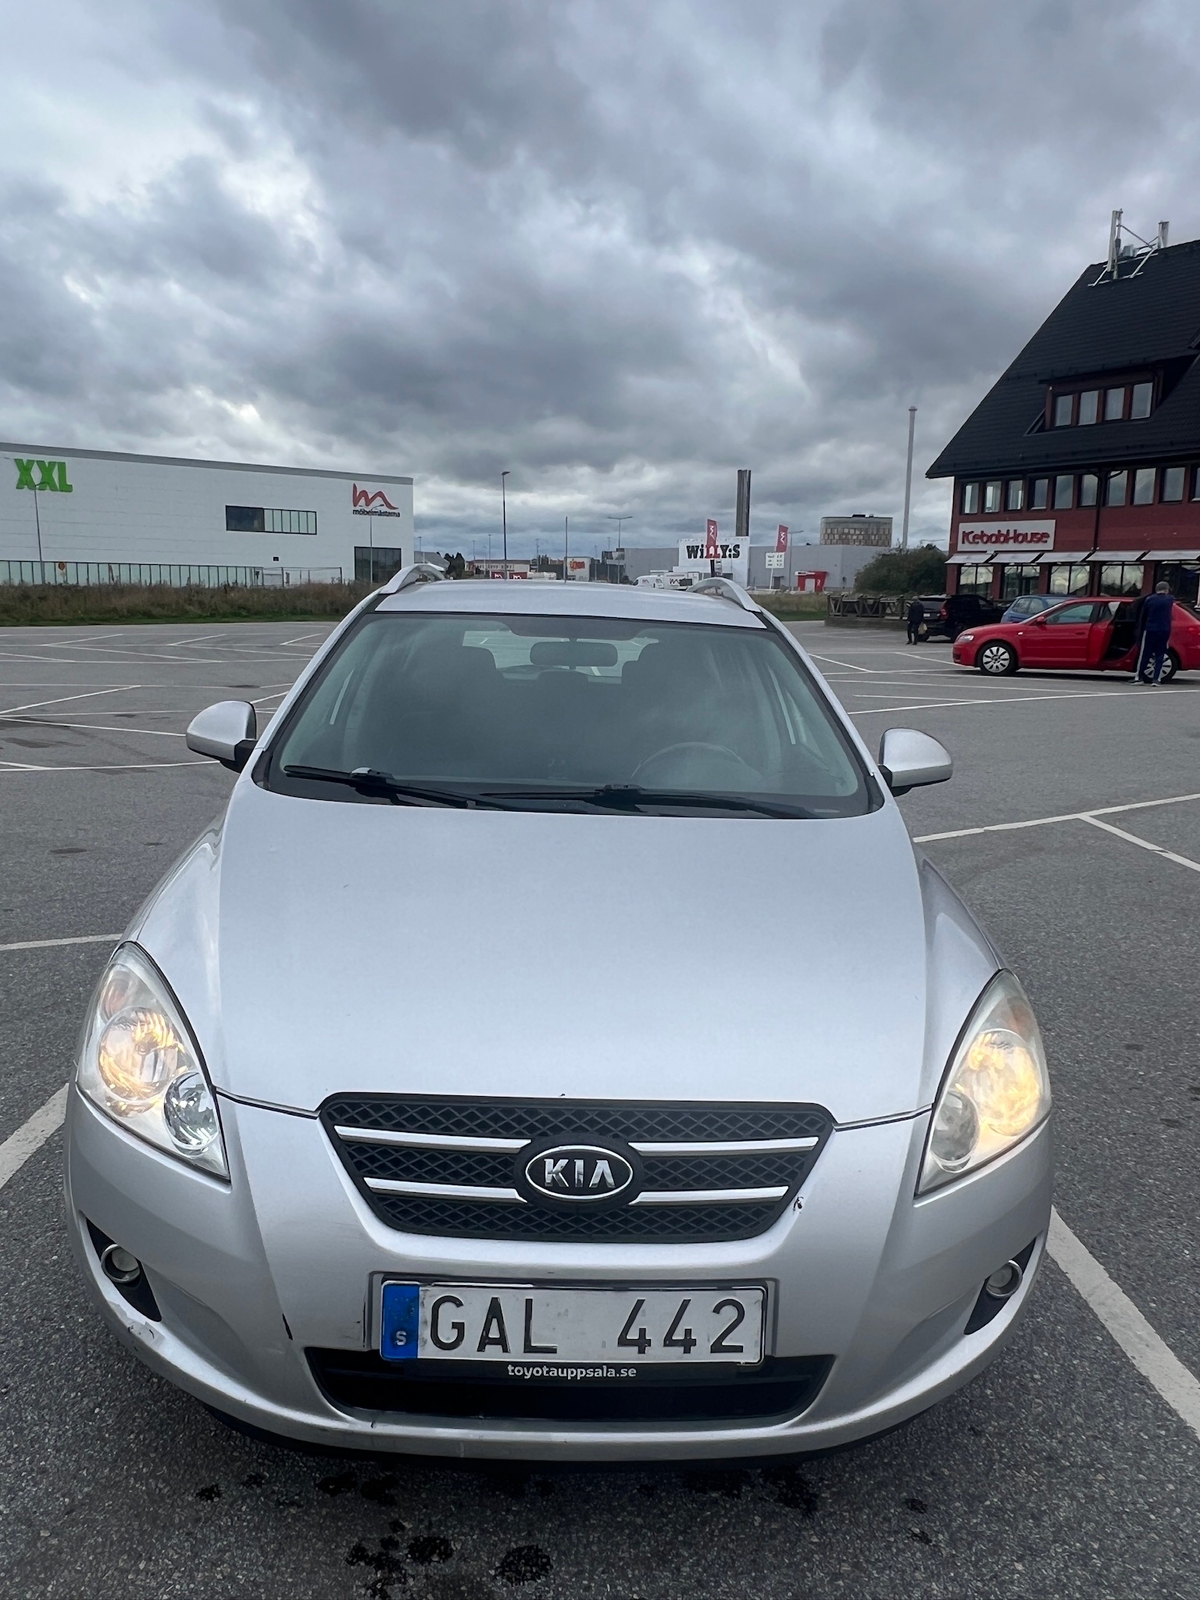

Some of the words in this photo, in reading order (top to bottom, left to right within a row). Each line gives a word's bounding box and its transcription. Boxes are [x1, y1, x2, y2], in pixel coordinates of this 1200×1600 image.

[14, 458, 73, 492] XXL
[544, 1159, 615, 1188] KIA
[395, 1330, 408, 1346] S
[430, 1295, 558, 1354] GAL
[617, 1298, 746, 1354] 442
[507, 1364, 637, 1379] toyotauppsala.se
